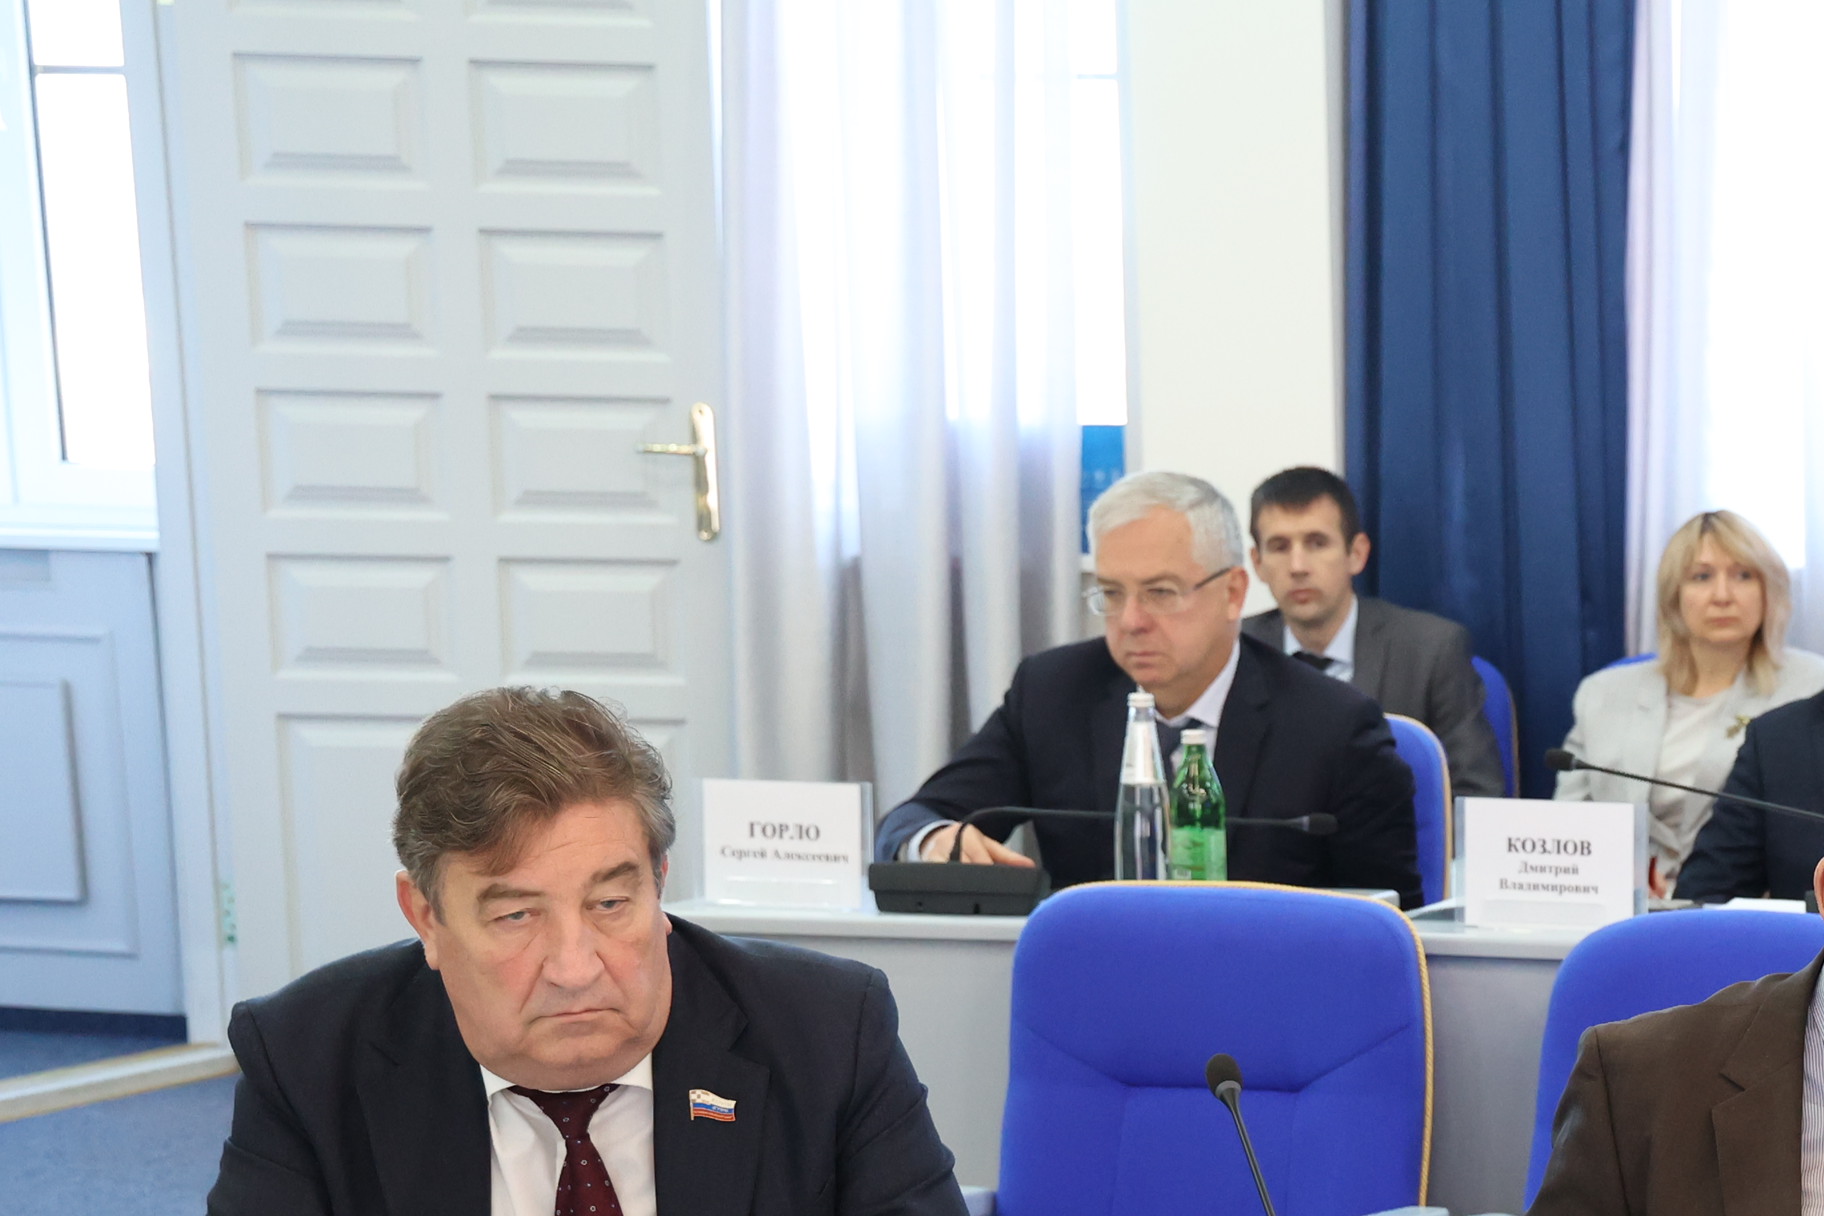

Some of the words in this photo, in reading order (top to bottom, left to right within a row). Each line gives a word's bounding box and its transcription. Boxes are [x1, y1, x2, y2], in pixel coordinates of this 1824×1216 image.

[749, 821, 821, 841] ГОРЛО
[720, 845, 768, 861] Сергей
[1507, 836, 1592, 856] КОЗЛОВ
[1518, 861, 1580, 877] Дмитрий
[1499, 878, 1599, 896] Владимирович
